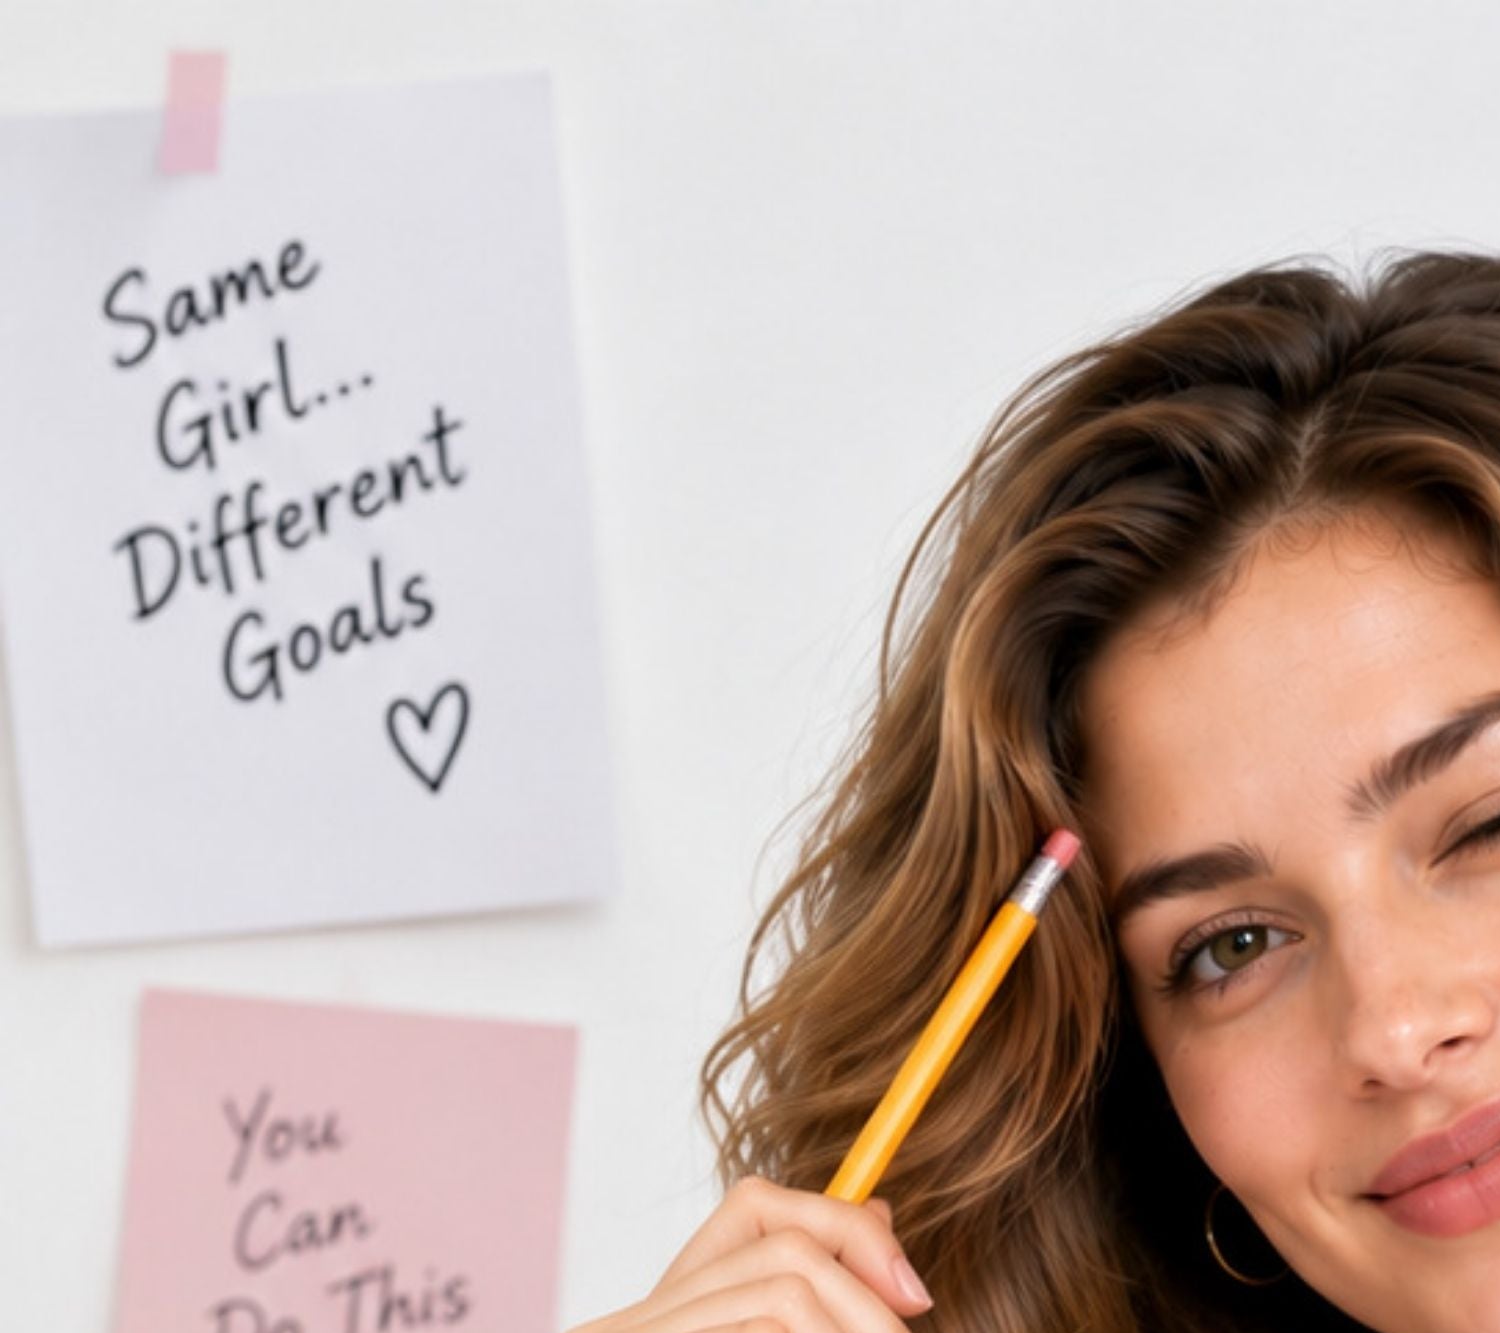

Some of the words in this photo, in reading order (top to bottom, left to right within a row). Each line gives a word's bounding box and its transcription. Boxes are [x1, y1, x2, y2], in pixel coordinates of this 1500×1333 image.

[101, 240, 320, 370] Same
[155, 337, 373, 472] Girl...
[114, 406, 464, 622] Different
[221, 555, 436, 704] Goals
[222, 1087, 346, 1186] You
[233, 1191, 374, 1274] Can
